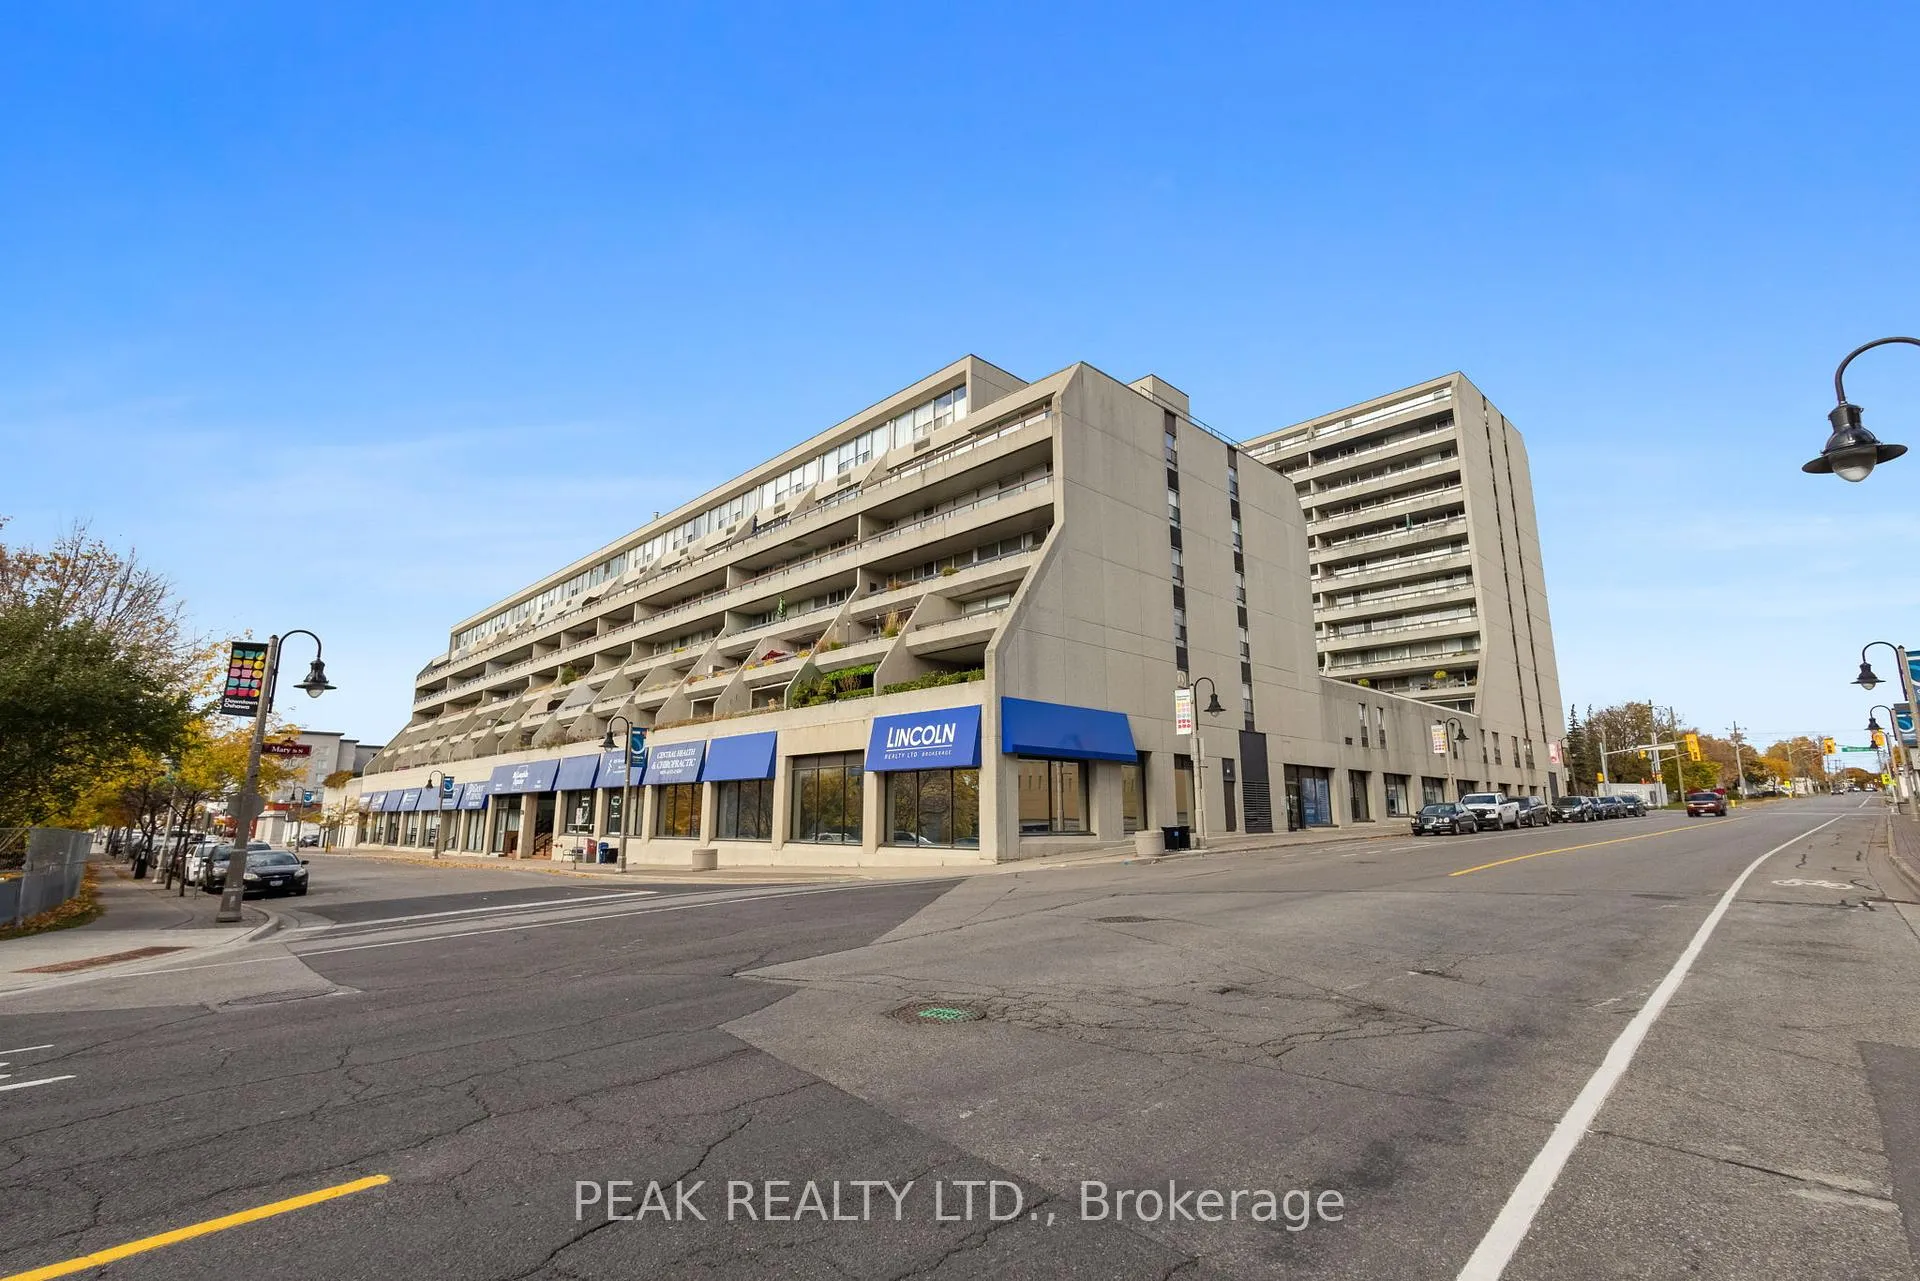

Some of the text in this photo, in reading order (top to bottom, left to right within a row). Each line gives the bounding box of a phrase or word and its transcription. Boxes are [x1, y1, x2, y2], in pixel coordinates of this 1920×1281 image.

[223, 702, 250, 710] Oshawa
[886, 722, 956, 748] LINCOLN
[271, 745, 291, 755] Mary
[677, 748, 696, 757] HEALTH
[884, 752, 905, 760] REALTY
[921, 749, 952, 757] BROKERAGE
[656, 758, 696, 769] CHIROPRACTIC
